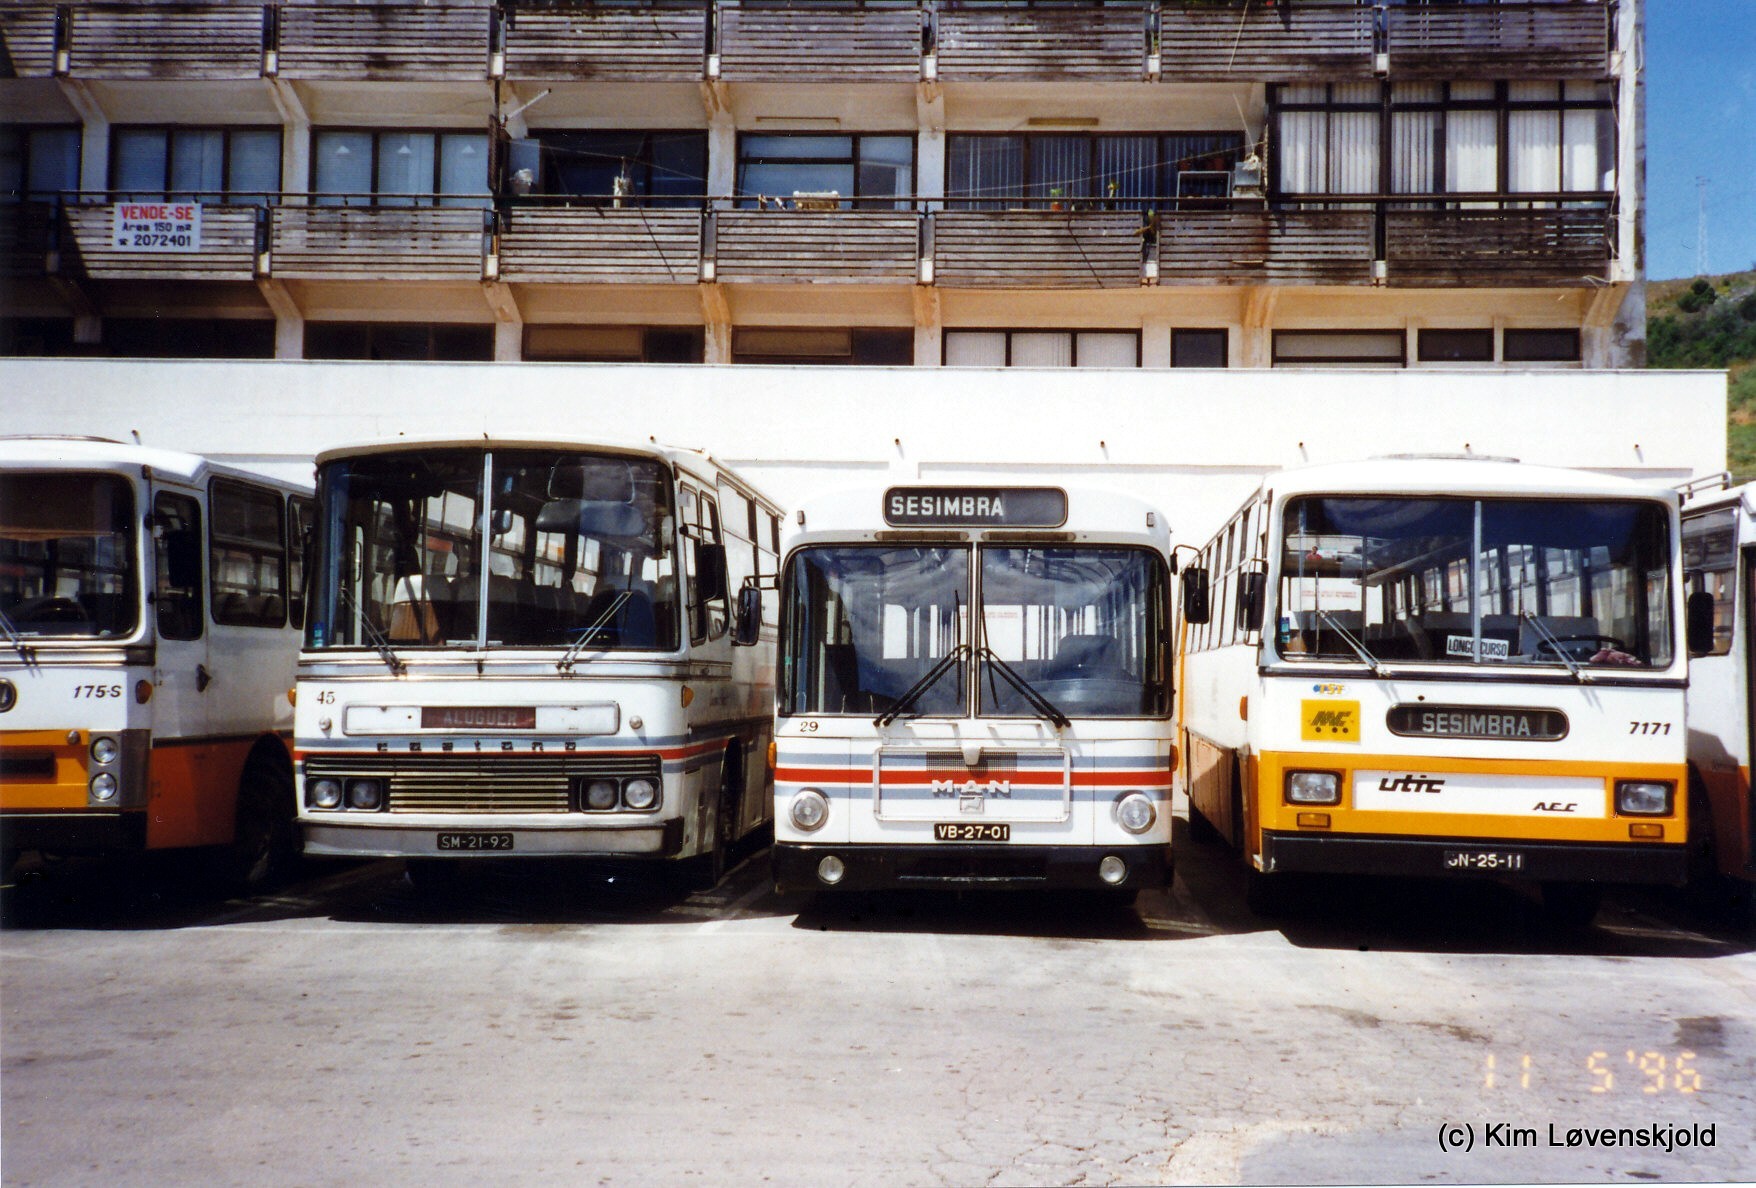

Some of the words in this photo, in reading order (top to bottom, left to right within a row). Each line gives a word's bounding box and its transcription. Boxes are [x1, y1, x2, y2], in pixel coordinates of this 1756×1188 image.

[121, 206, 195, 220] VENDE-SE
[154, 222, 172, 232] 150
[134, 234, 191, 246] 2072401
[891, 496, 1004, 516] SESIMBRA
[1480, 641, 1507, 657] CURSO
[73, 685, 122, 699] 175-S
[316, 691, 336, 704] 45
[443, 710, 518, 727] ALUGUER
[1422, 713, 1531, 736] SESIMBRA
[799, 720, 819, 733] 29
[1629, 721, 1671, 735] 7171
[931, 779, 1011, 794] MAN
[1378, 774, 1446, 794] utic
[1532, 801, 1578, 813] AEC
[938, 825, 1009, 840] VB-27-01
[441, 835, 510, 848] SM-21-92
